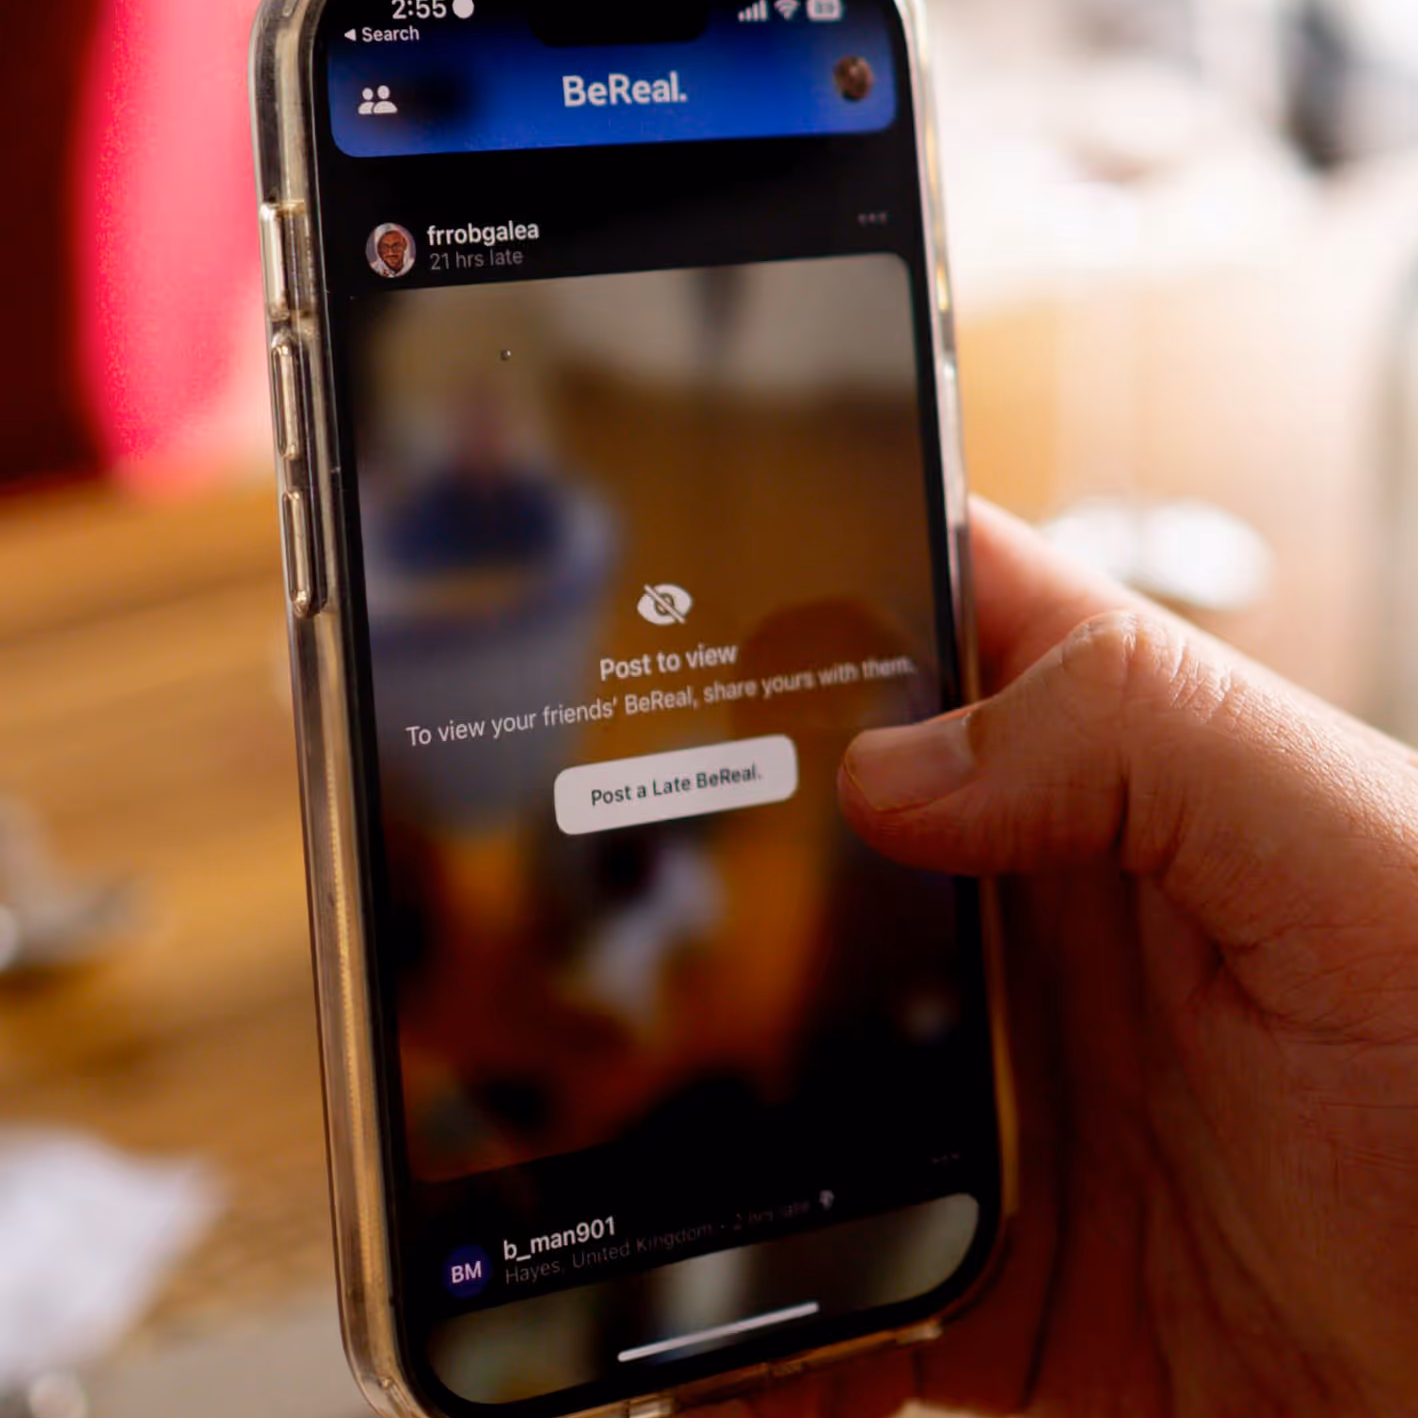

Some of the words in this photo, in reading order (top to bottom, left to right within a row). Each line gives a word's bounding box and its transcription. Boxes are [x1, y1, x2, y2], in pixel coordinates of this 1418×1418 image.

[362, 25, 420, 43] Search
[563, 71, 688, 107] BeReal.
[427, 220, 540, 248] frrobgalea
[430, 253, 451, 270] 21
[455, 250, 486, 269] hrs
[489, 247, 524, 267] late
[599, 655, 652, 682] Post
[656, 652, 681, 674] to
[685, 643, 739, 668] view
[406, 726, 432, 747] To
[437, 718, 486, 742] view
[491, 712, 537, 739] your
[624, 688, 699, 716] BeReal,
[703, 680, 757, 704] share
[761, 672, 815, 700] yours
[818, 663, 858, 688] with
[591, 785, 632, 807] Post
[636, 784, 647, 799] a
[652, 776, 691, 797] Late
[696, 763, 763, 790] BeReal.
[503, 1216, 617, 1262] b_man901
[505, 1259, 566, 1285] Hayes,
[572, 1237, 632, 1270] United
[635, 1221, 714, 1255] Kingdom
[451, 1260, 483, 1284] BM
